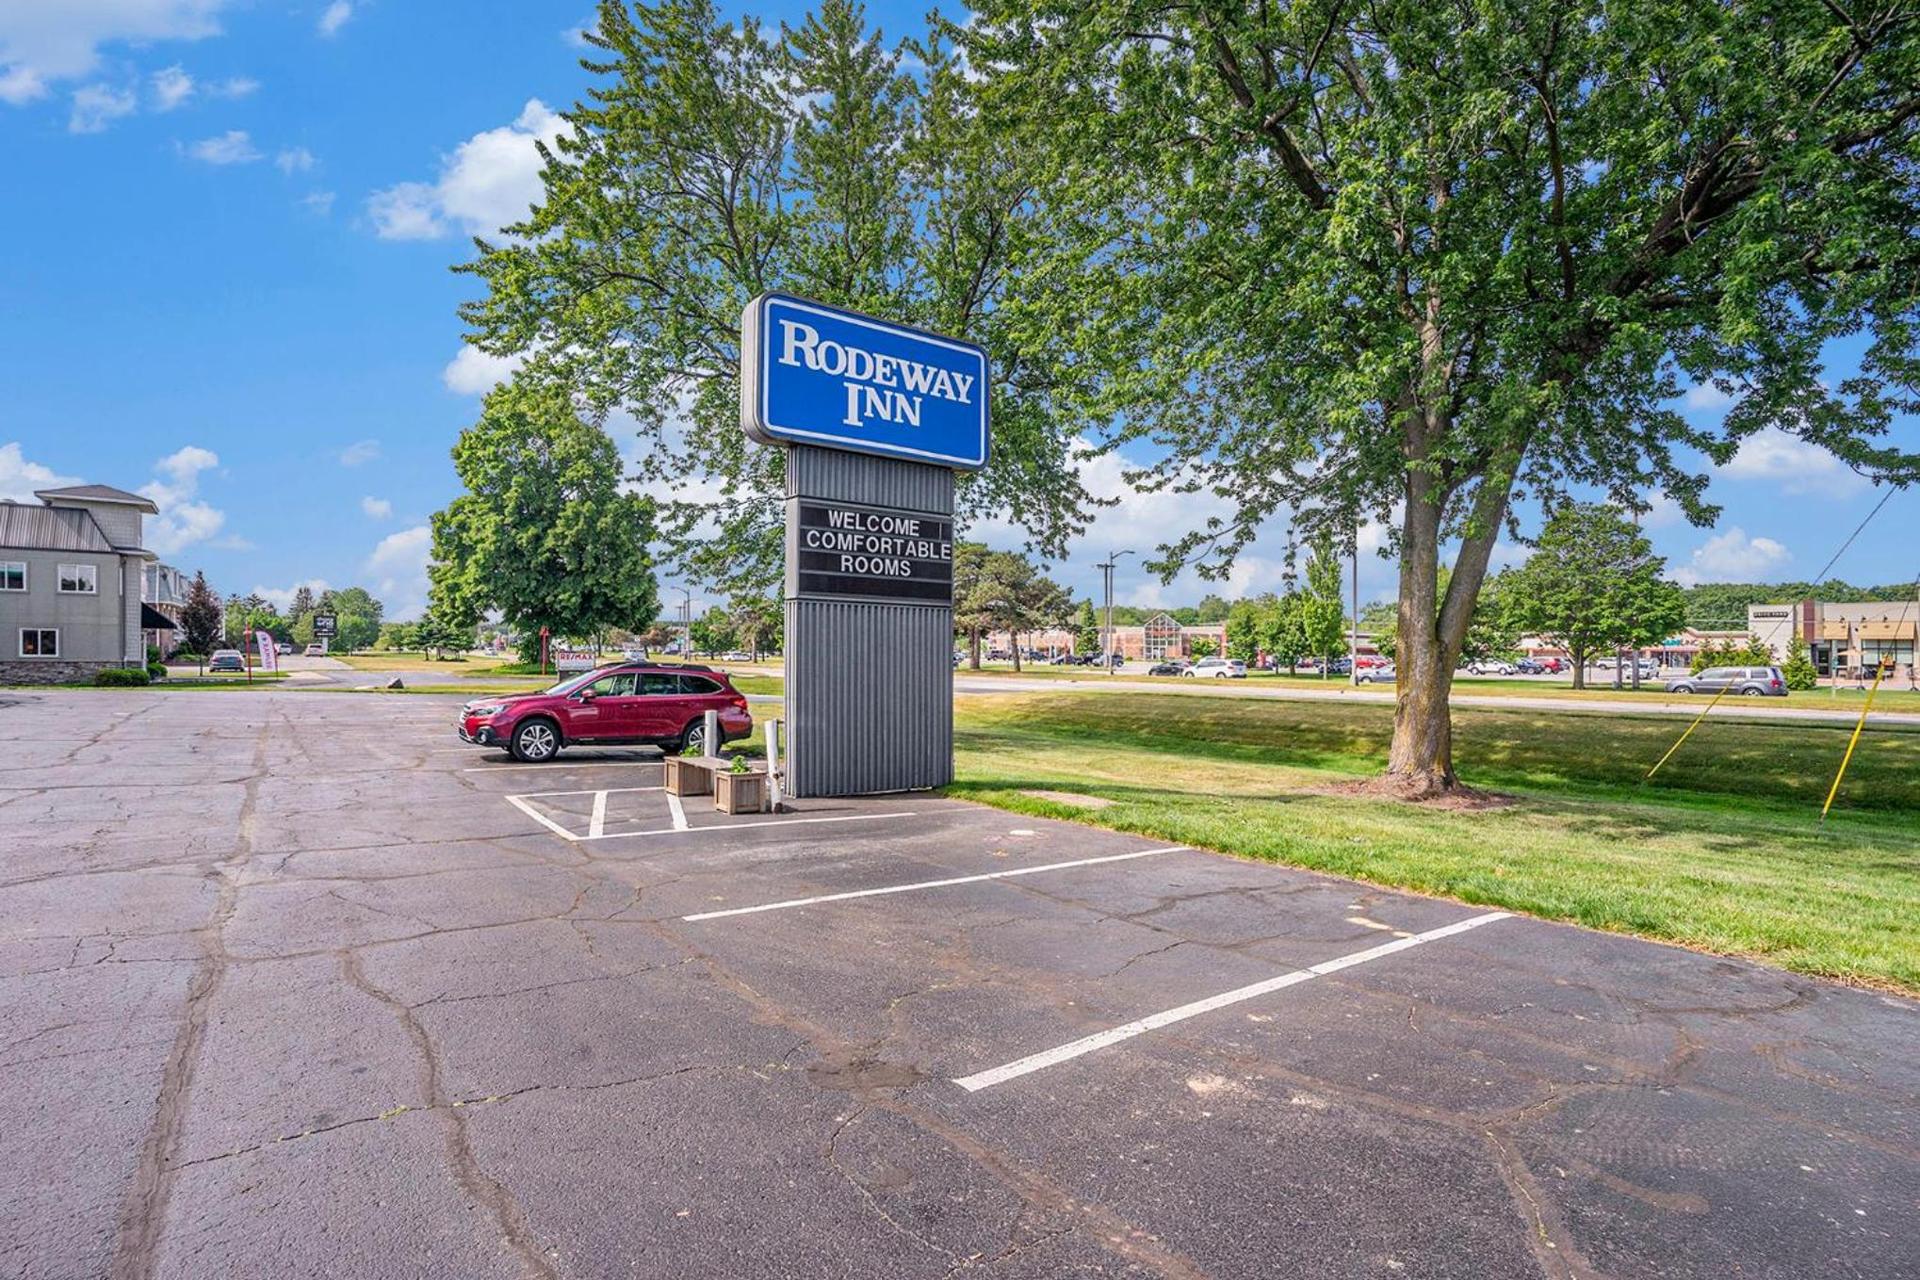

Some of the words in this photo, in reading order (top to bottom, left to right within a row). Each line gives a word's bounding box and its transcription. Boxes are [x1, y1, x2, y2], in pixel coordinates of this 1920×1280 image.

[778, 319, 975, 405] RODEWAY
[843, 382, 923, 427] INN
[828, 510, 920, 537] WELCOME
[806, 530, 951, 560] COMFORTABLE
[841, 554, 912, 577] ROOMS
